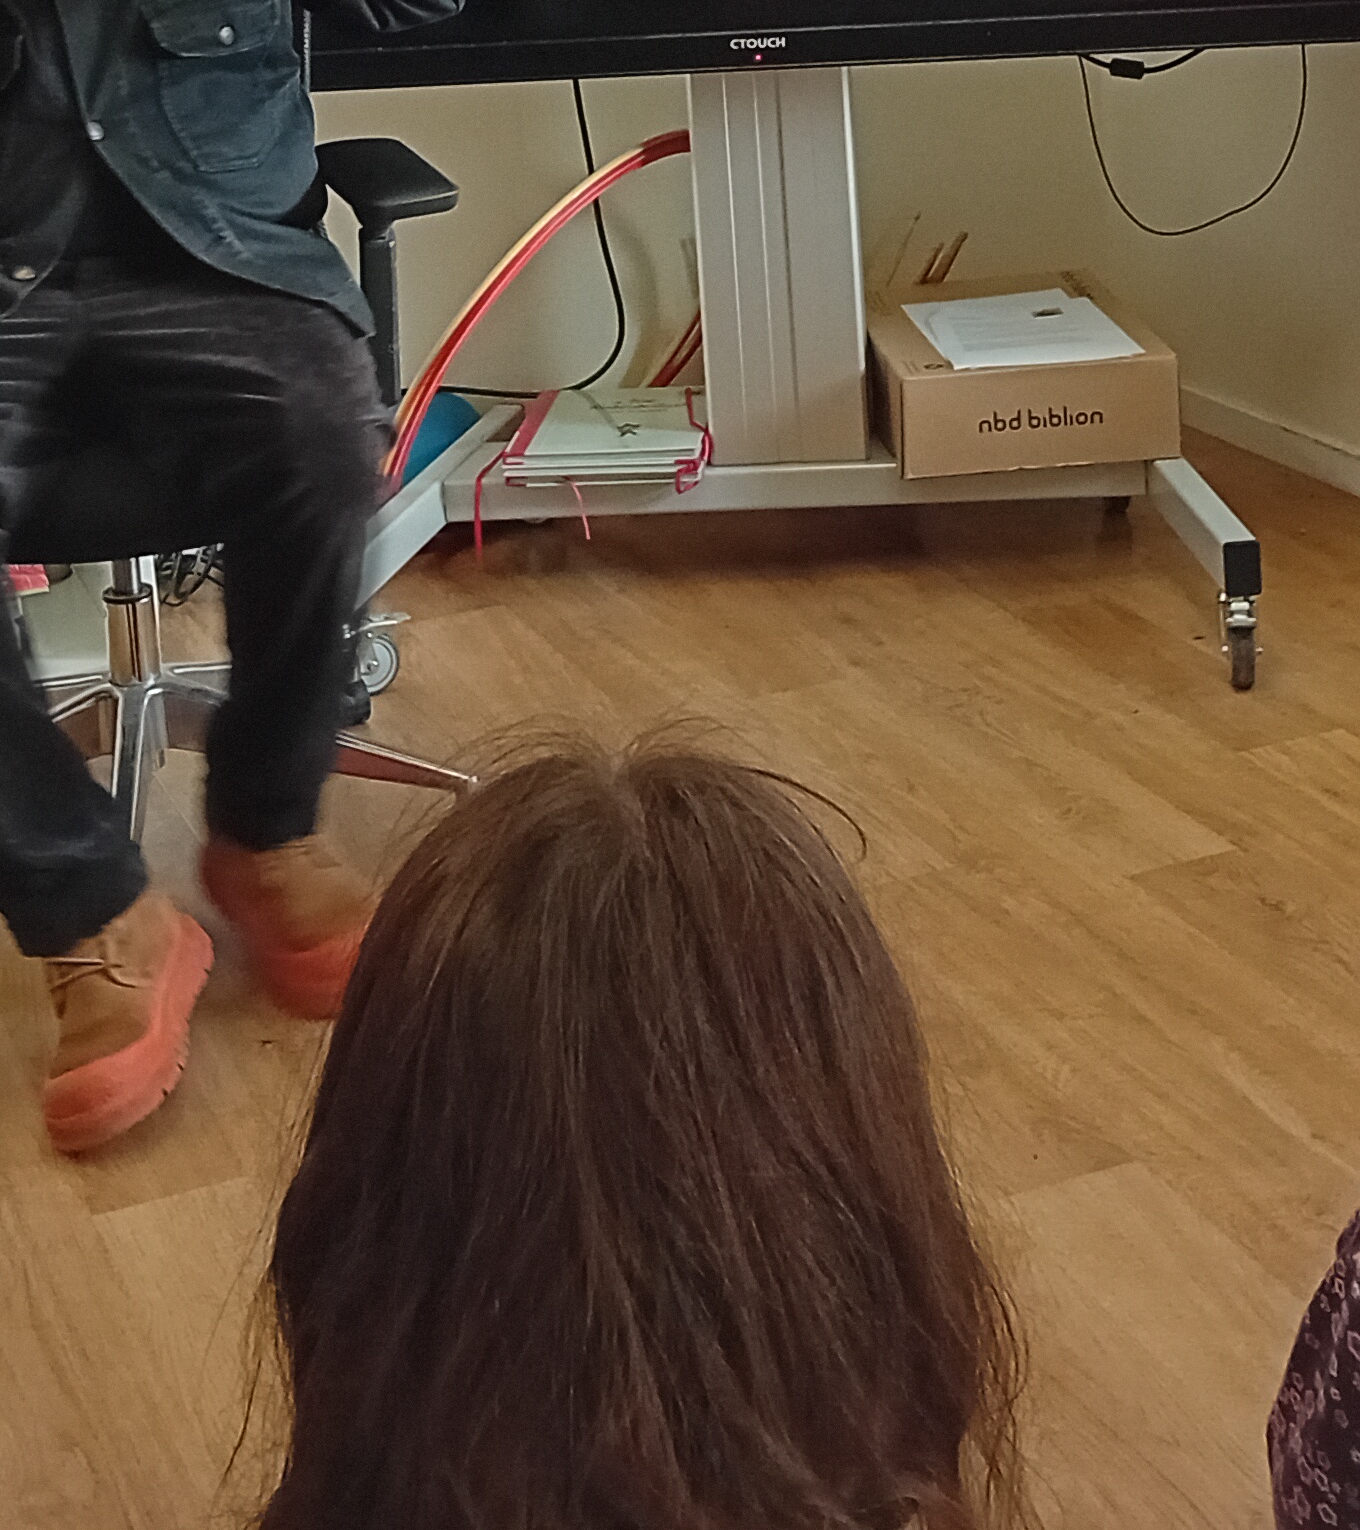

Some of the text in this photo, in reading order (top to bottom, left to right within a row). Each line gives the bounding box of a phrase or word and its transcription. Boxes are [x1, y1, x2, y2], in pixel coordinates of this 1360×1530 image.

[729, 37, 786, 50] CTOUCH
[978, 406, 1104, 434] nbd biblion
